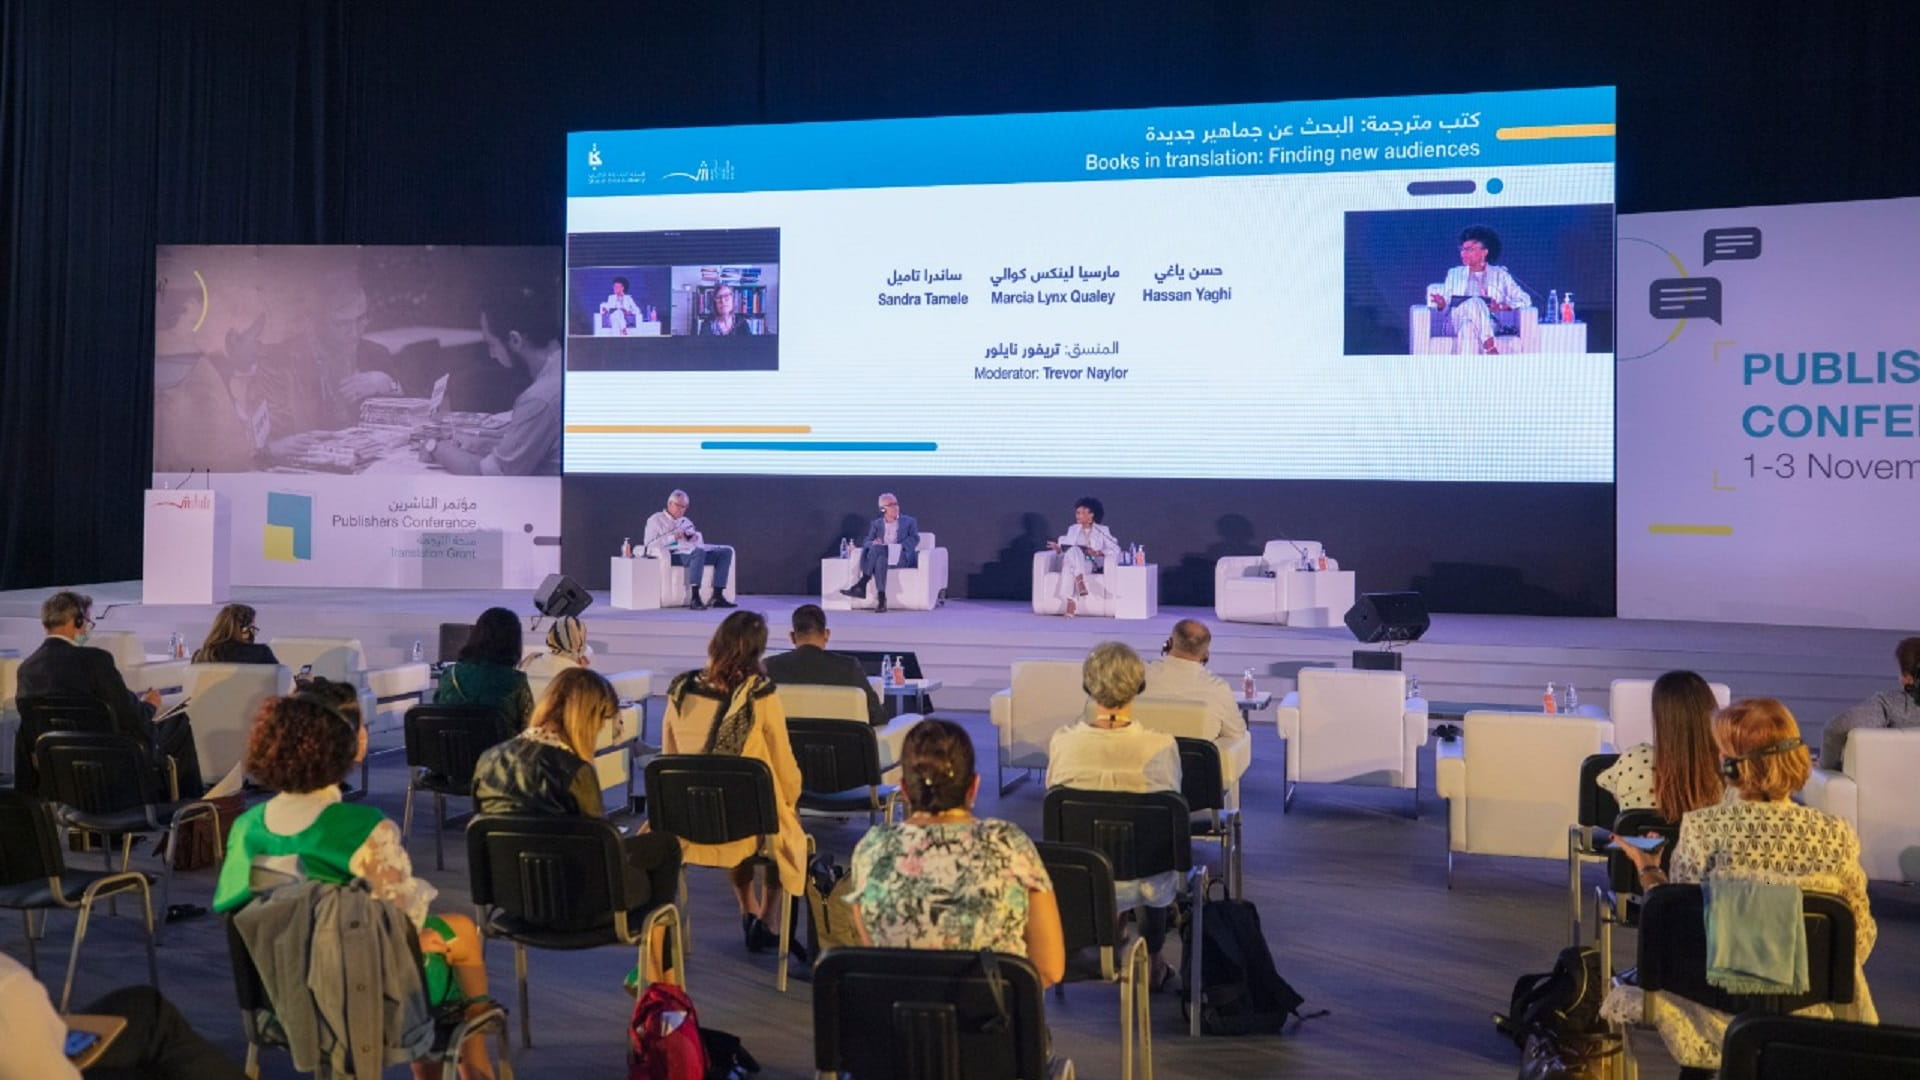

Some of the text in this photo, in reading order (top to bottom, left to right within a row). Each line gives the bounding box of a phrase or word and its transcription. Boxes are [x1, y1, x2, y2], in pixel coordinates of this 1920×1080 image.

[1145, 112, 1481, 146] كتب مترجمة: البحث عن جماهير جديدة
[1086, 141, 1480, 171] Books in translation: Finding new audiences
[887, 268, 963, 286] ساندرا تاميل
[990, 265, 1120, 287] مارسيا لينكس كوالي
[1154, 263, 1223, 284] حسن ياغي
[878, 292, 969, 306] Sandra Tamele
[991, 289, 1116, 306] Marcia Lynx Qualey
[1143, 286, 1232, 303] Hassan Yaghi
[984, 342, 1018, 359] نايلور
[1021, 343, 1060, 359] تريفور
[974, 366, 1128, 382] Moderator: Trevor Naylor
[1742, 404, 1920, 438] CONFE
[1743, 453, 1795, 479] 1-3
[442, 496, 477, 512] مؤتمر
[332, 514, 477, 528] Publishers Conference
